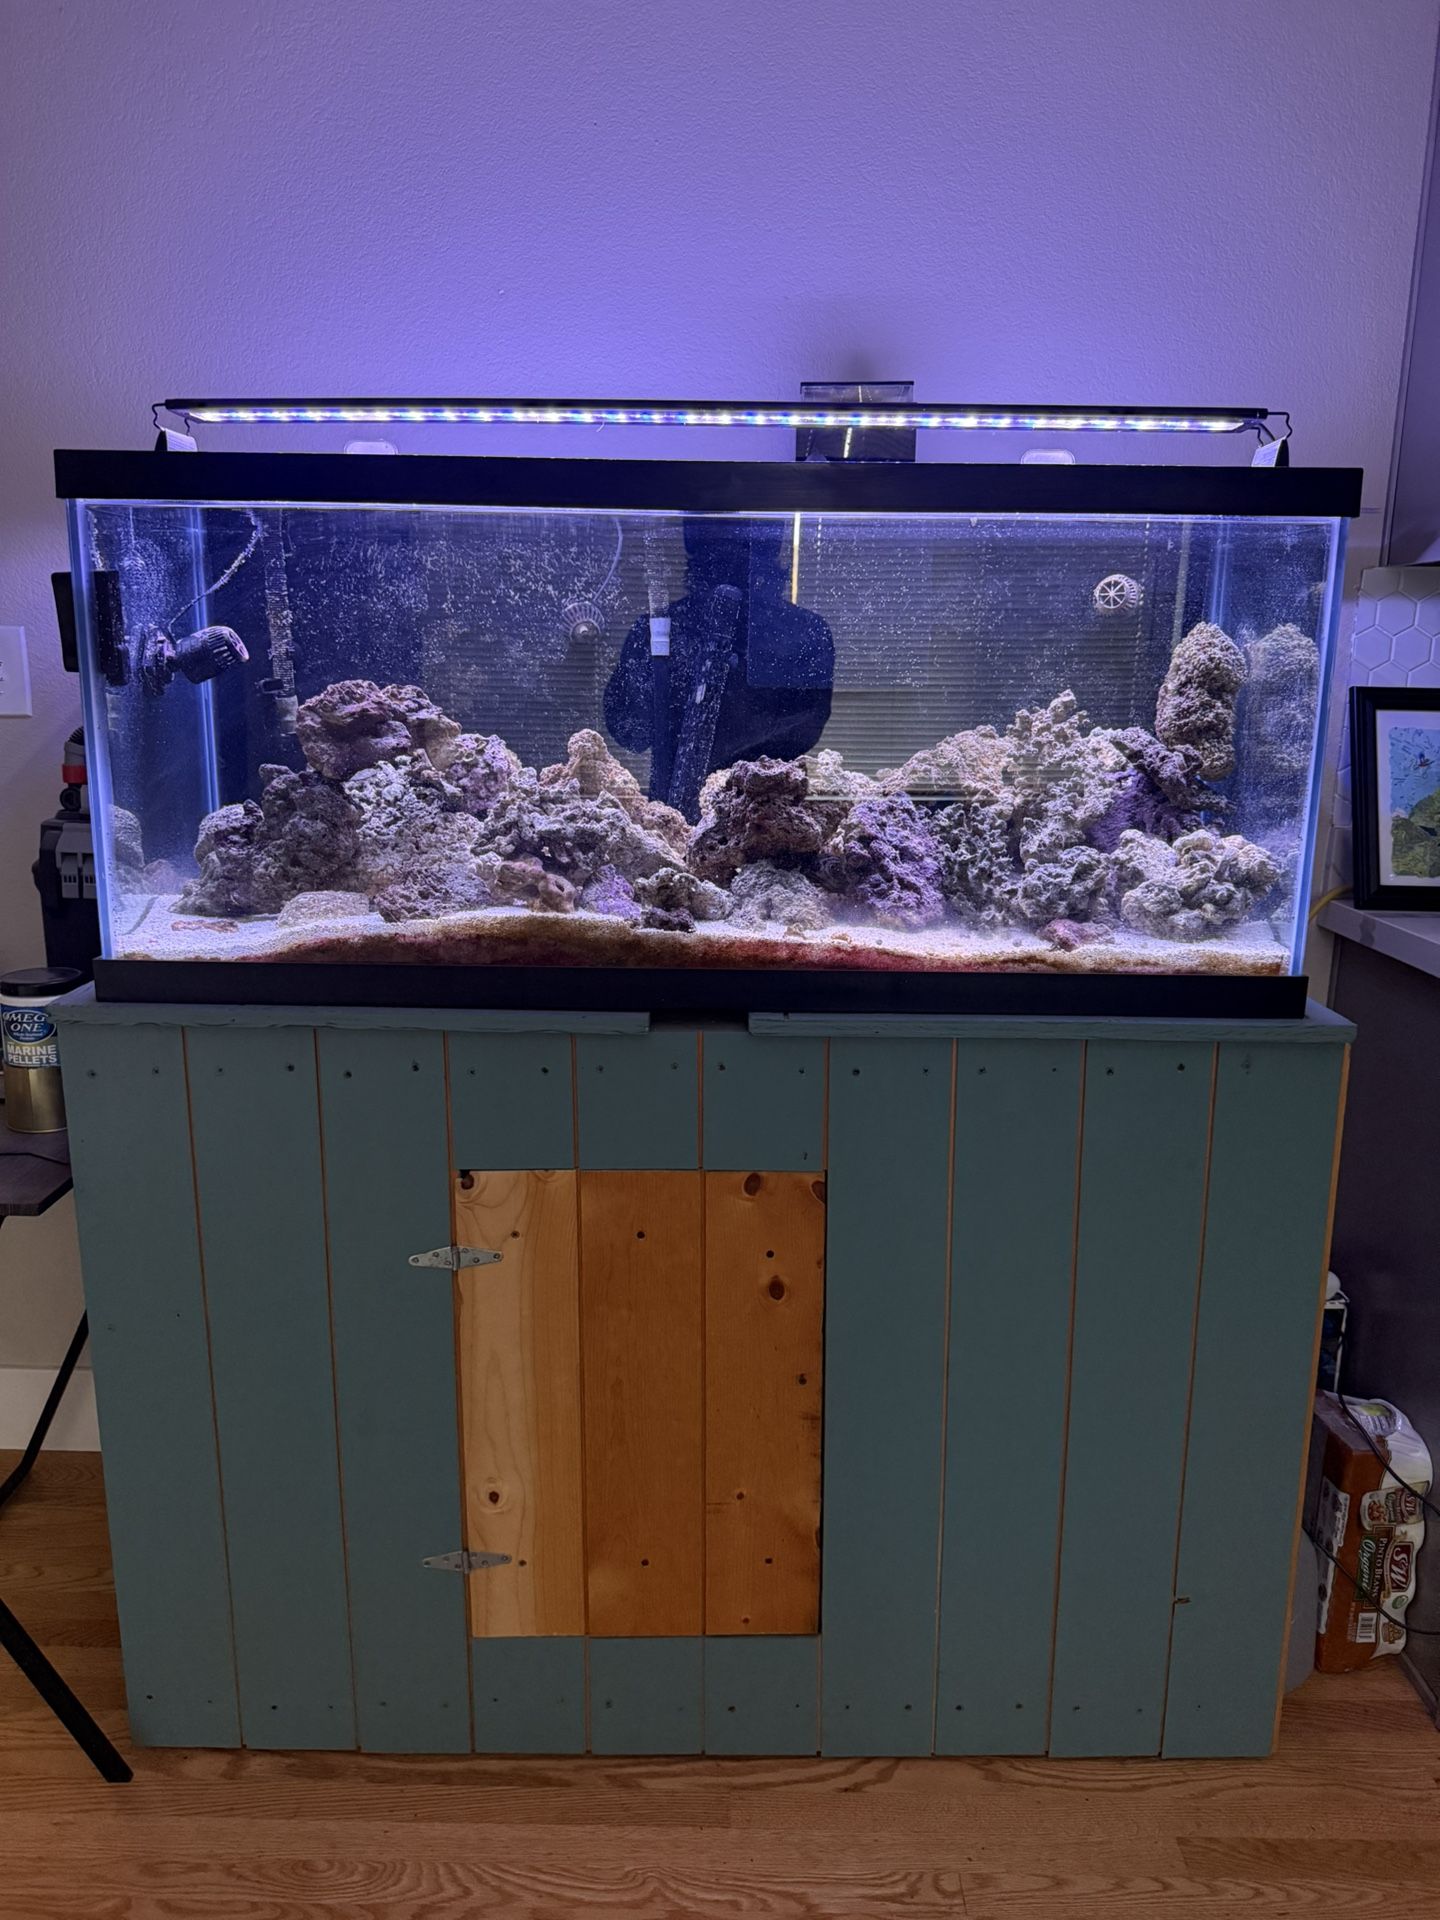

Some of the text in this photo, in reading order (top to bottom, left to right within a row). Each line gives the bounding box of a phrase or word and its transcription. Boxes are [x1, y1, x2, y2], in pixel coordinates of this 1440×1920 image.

[3, 1011, 48, 1022] OMEG
[11, 1022, 44, 1031] ONE
[7, 1044, 57, 1056] MARINE
[8, 1054, 57, 1064] PELLETS
[1359, 1539, 1376, 1594] Organi
[1391, 1547, 1409, 1588] S&W
